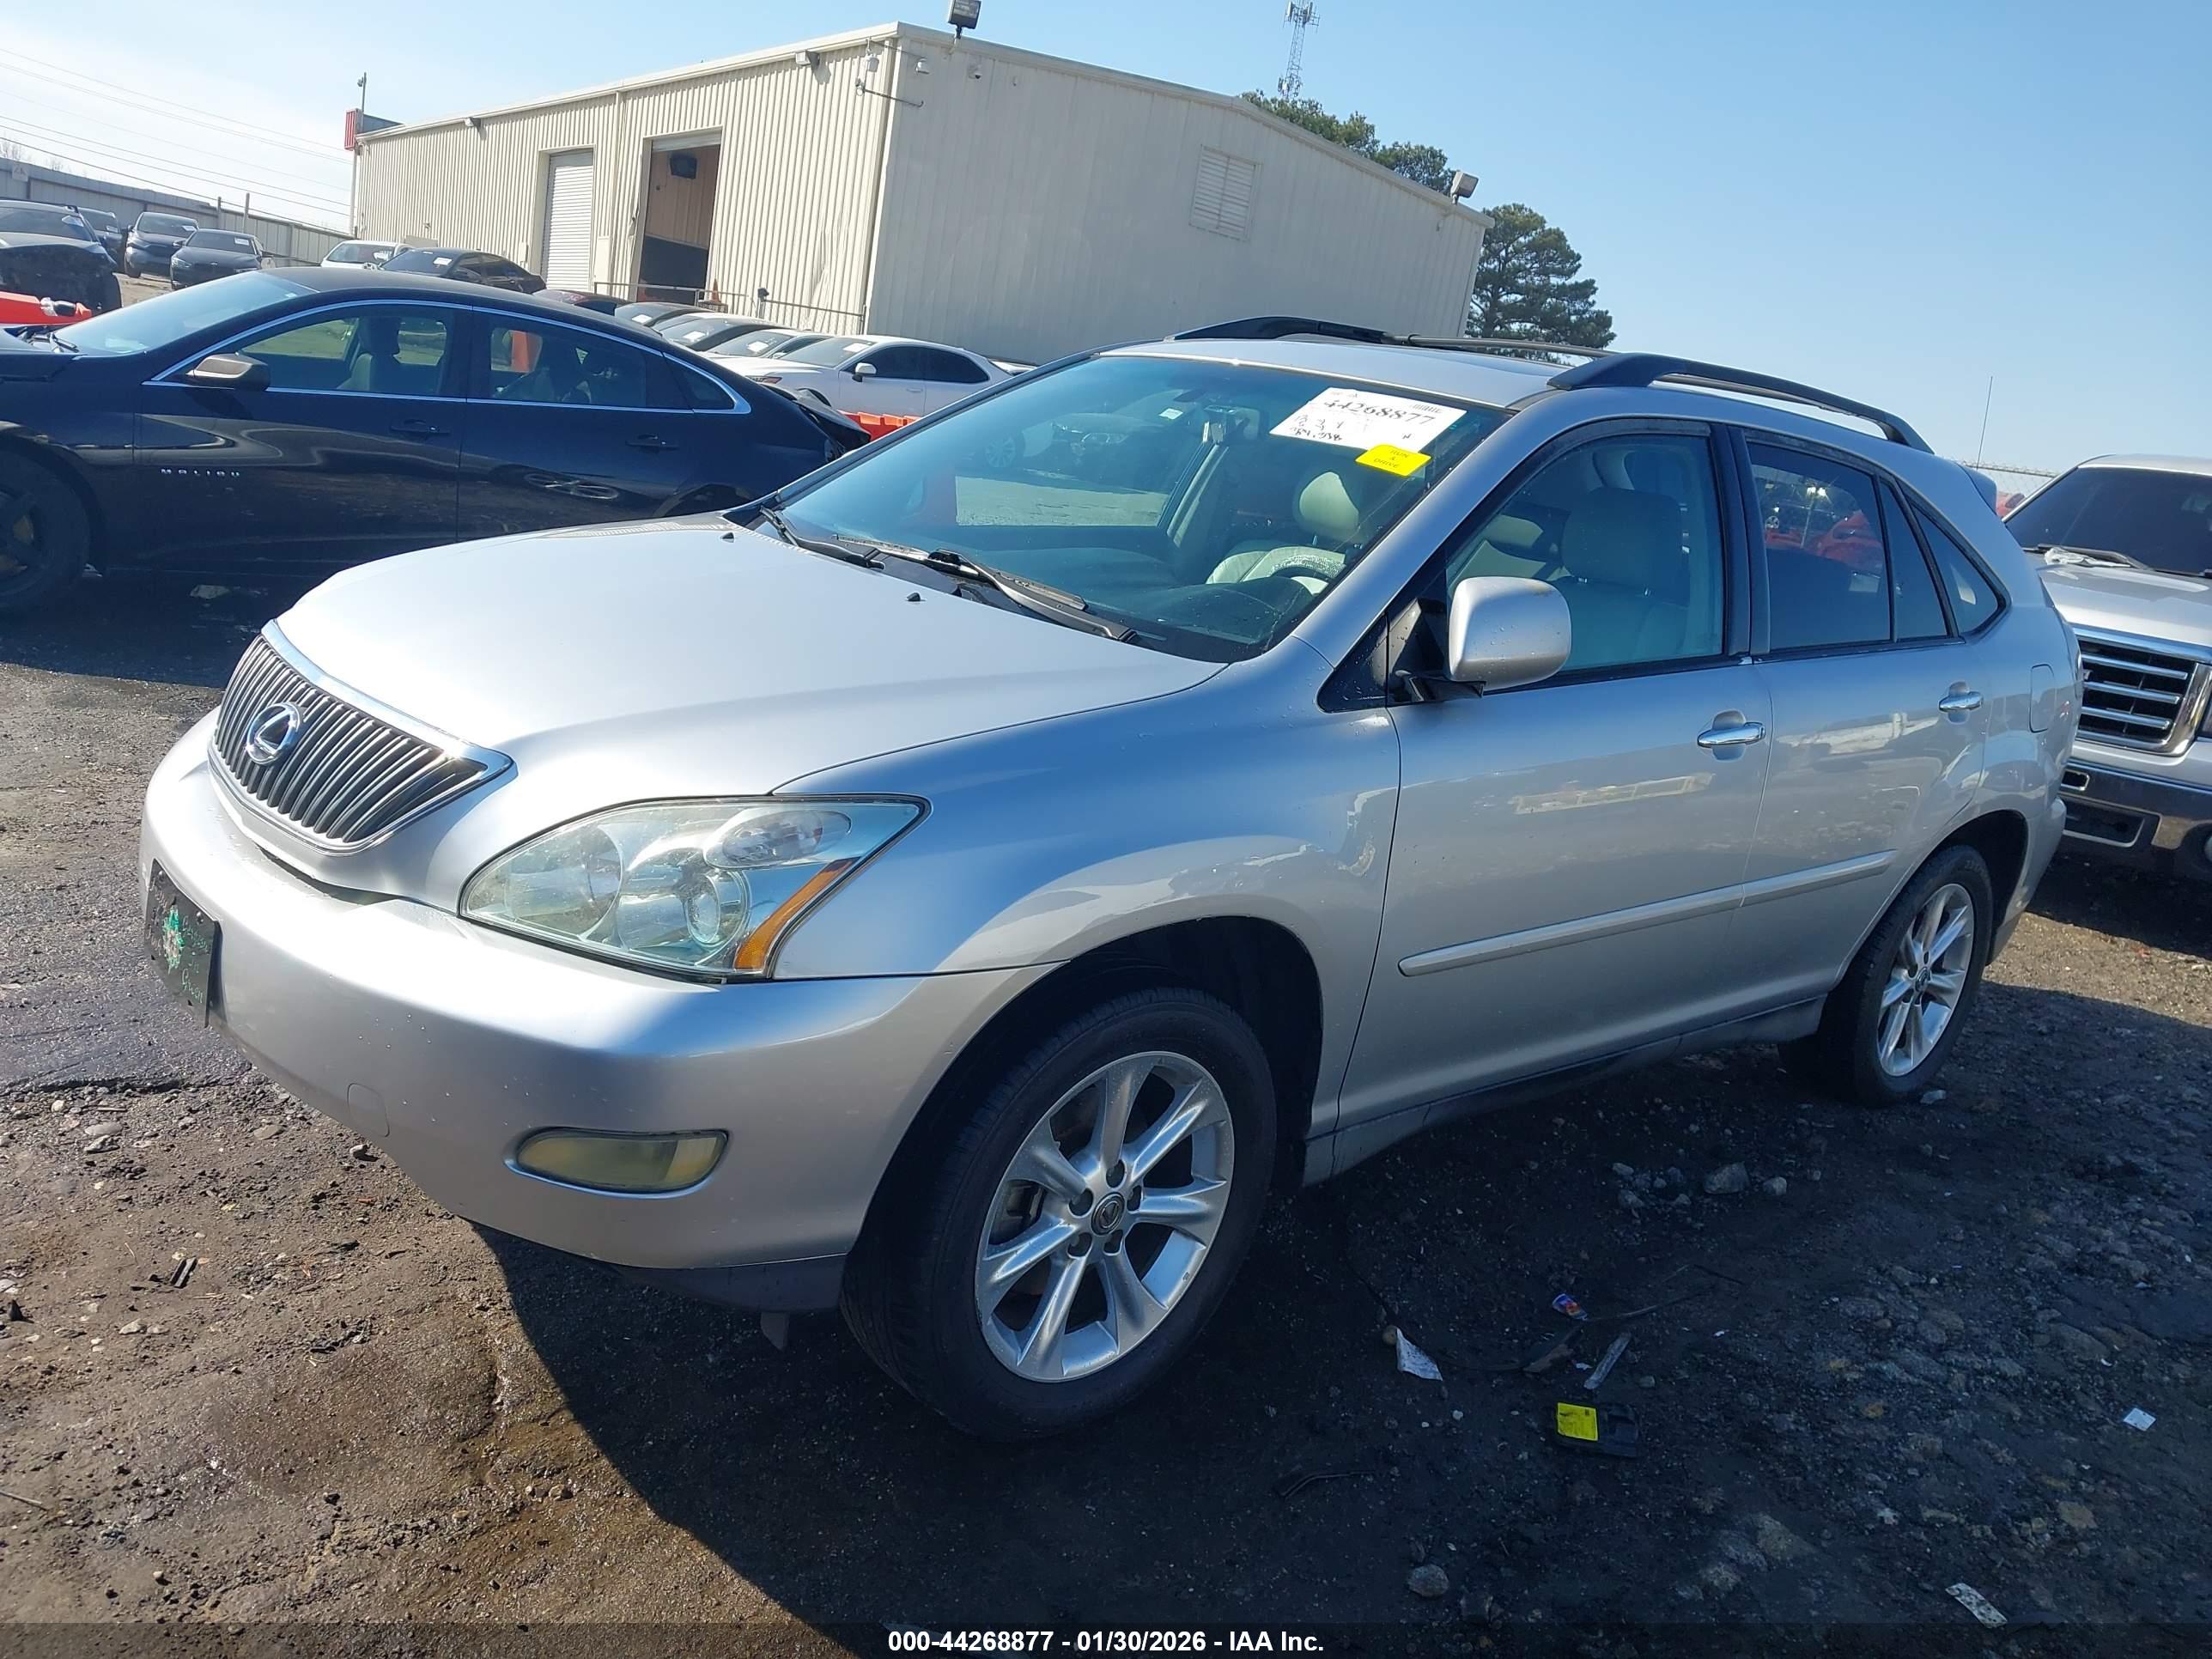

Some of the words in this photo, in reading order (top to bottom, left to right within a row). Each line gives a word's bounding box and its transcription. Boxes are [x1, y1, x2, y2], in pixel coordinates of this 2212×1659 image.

[1323, 399, 1436, 425] 44268877
[1389, 448, 1410, 459] RUN
[1373, 457, 1401, 469] DRIVE
